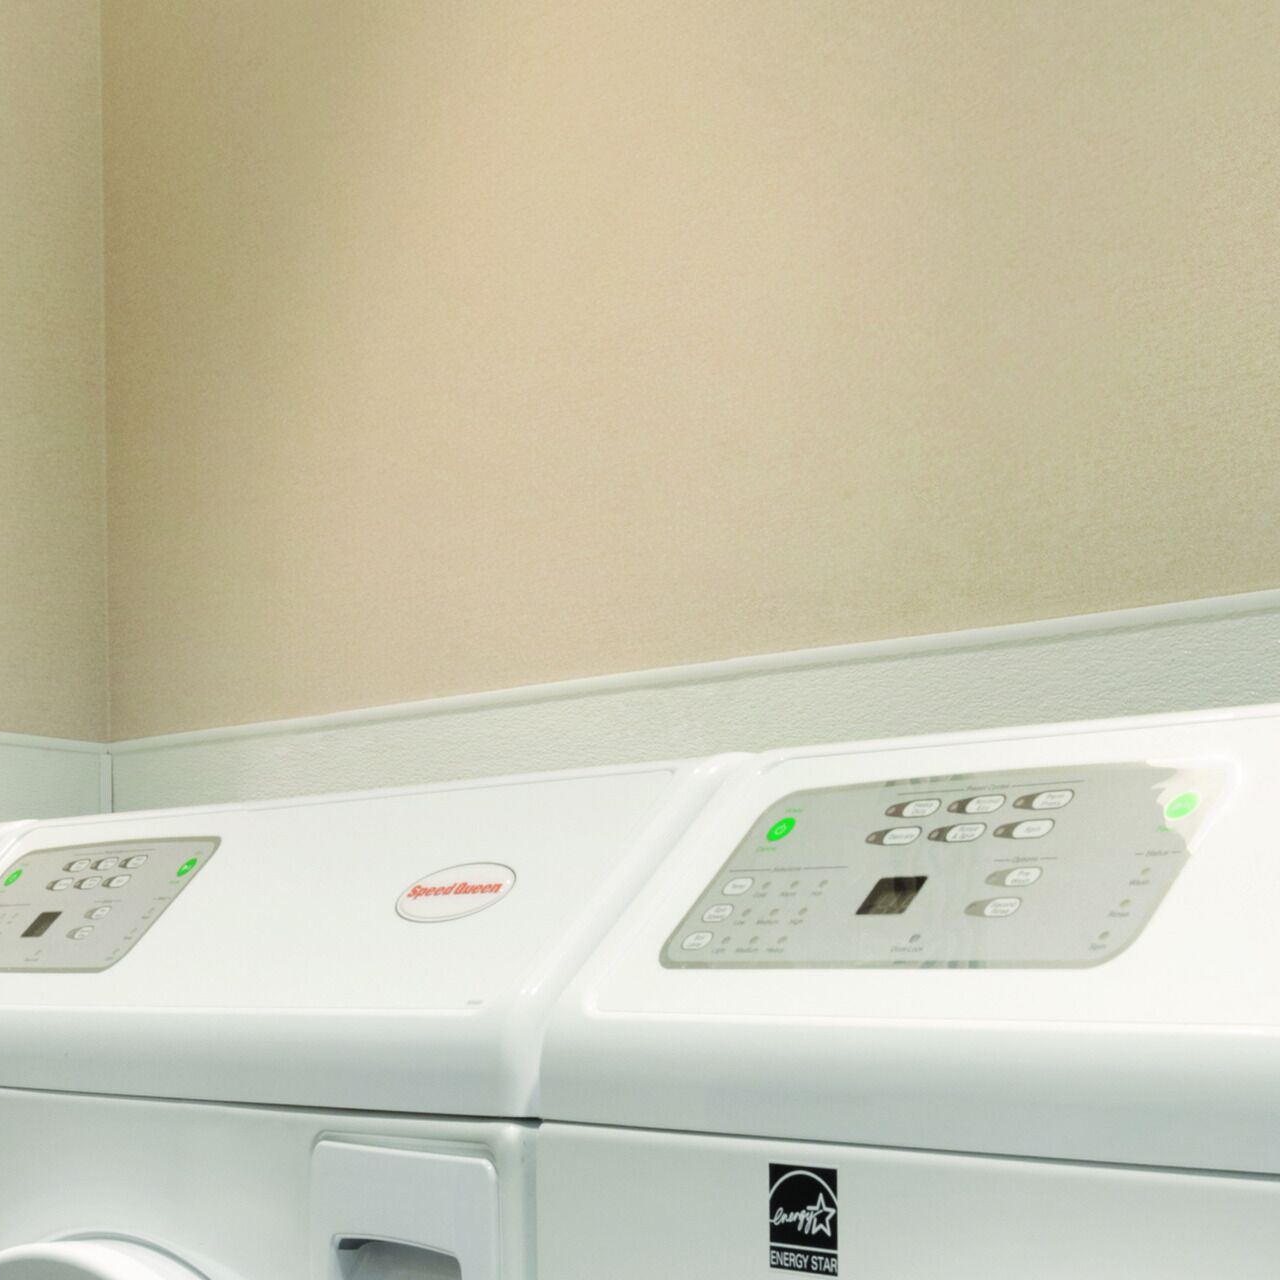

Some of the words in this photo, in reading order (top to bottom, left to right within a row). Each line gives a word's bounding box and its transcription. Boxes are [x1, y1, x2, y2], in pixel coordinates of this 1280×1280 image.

[407, 883, 457, 900] Speed
[453, 882, 502, 895] Queen
[770, 1250, 808, 1269] ENERGY
[810, 1255, 838, 1273] STAR
